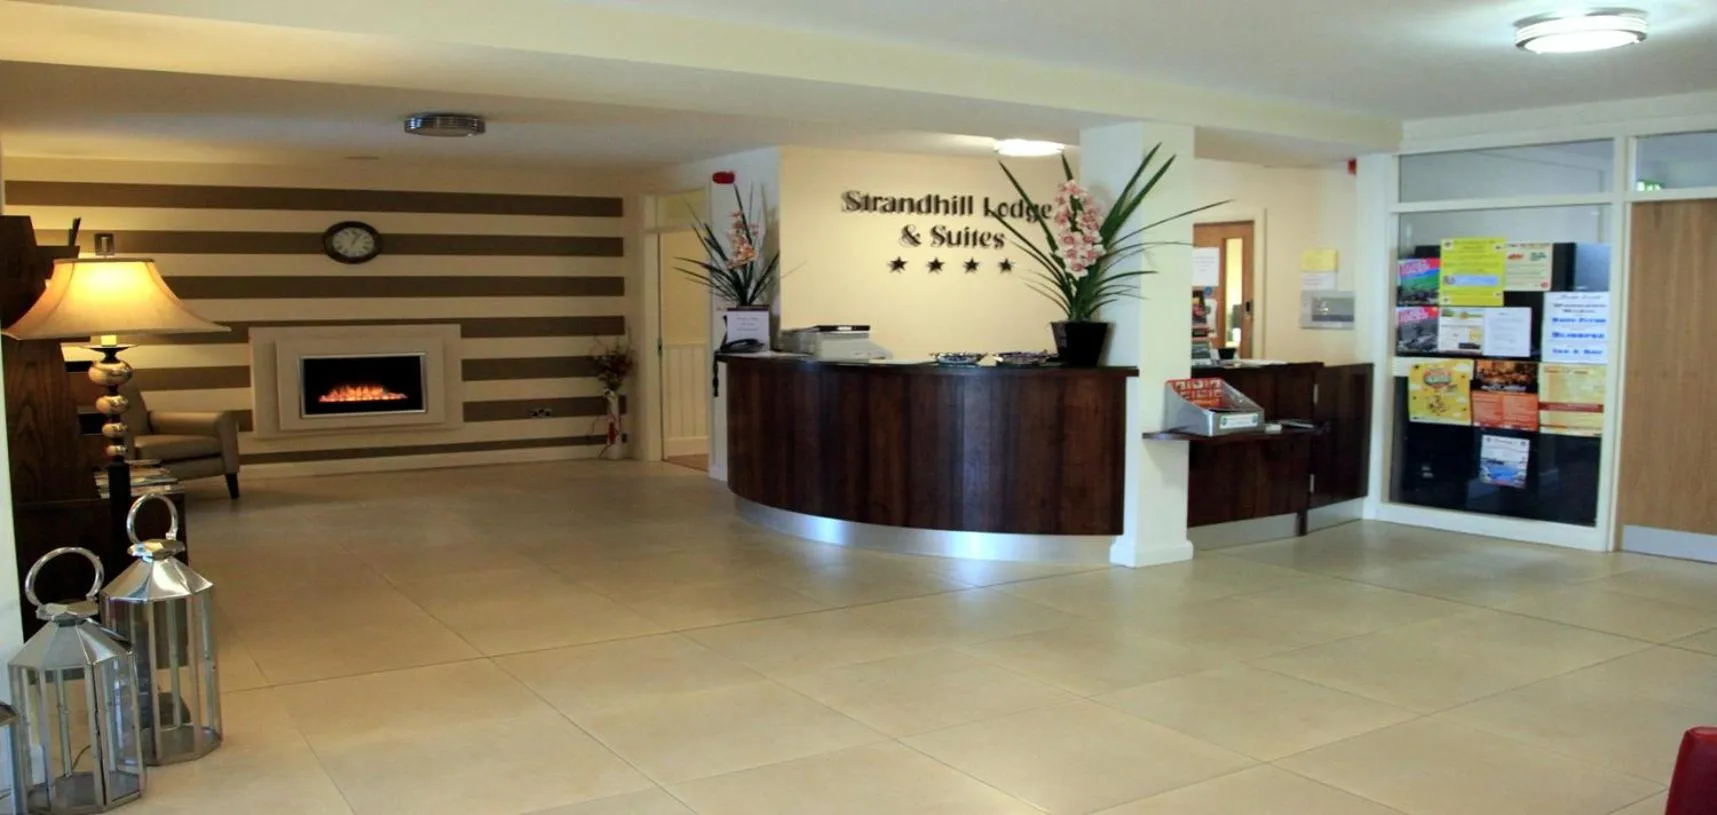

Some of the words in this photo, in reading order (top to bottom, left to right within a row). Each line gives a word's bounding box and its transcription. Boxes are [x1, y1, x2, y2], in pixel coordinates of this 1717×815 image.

[842, 190, 973, 216] Strandhill
[984, 197, 1052, 222] Lodge
[899, 224, 922, 247] &
[930, 224, 1005, 249] Suites
